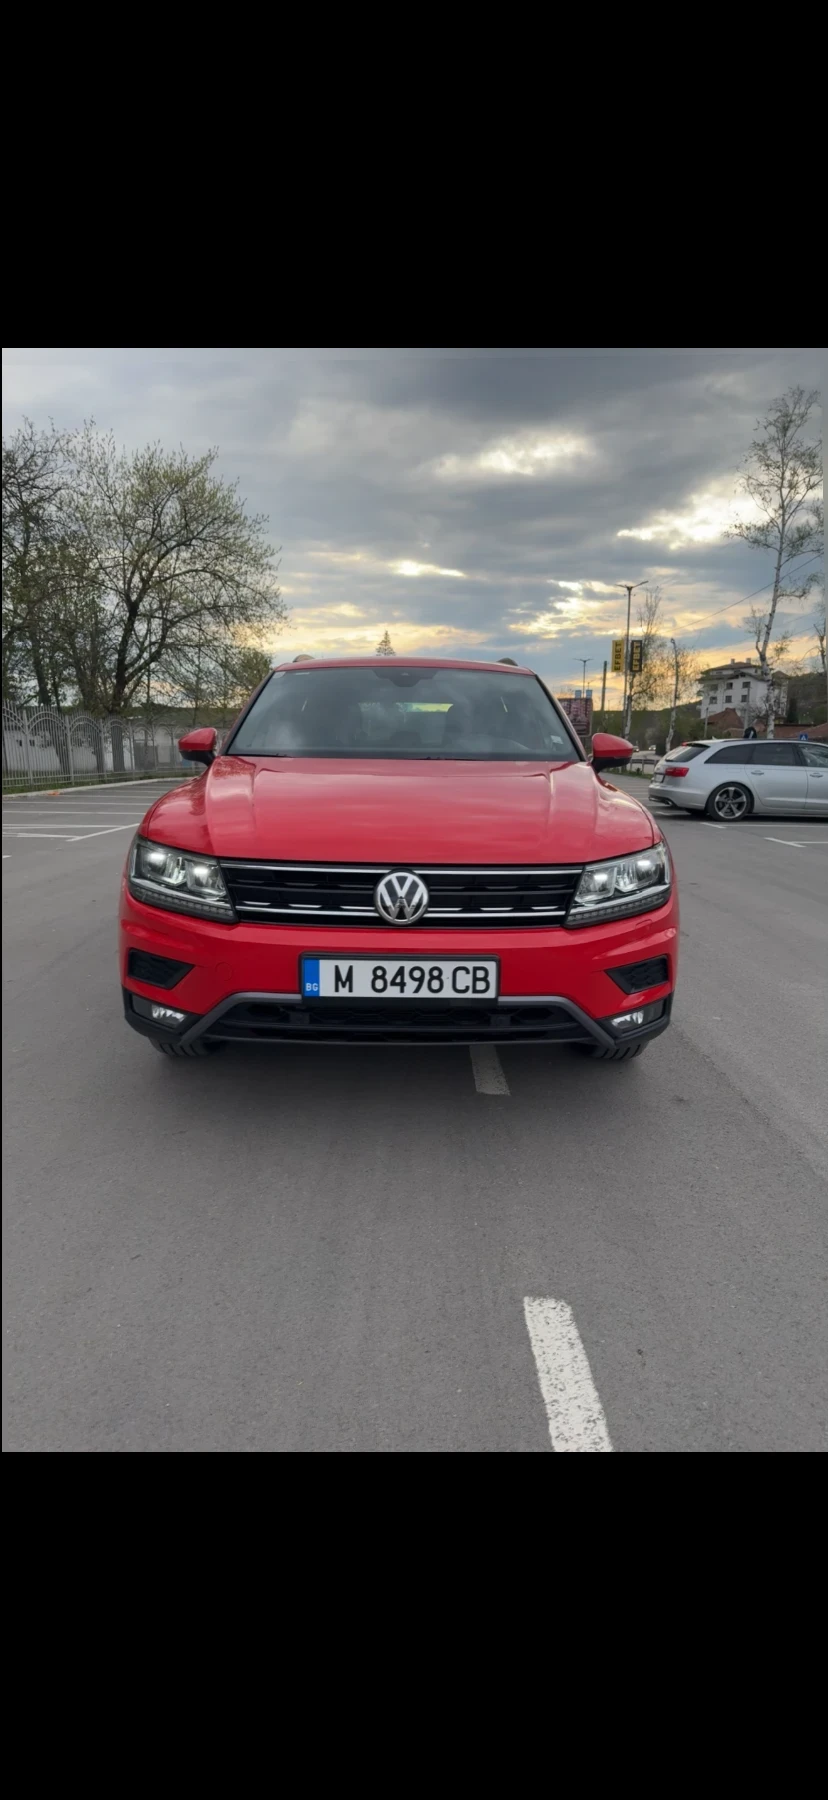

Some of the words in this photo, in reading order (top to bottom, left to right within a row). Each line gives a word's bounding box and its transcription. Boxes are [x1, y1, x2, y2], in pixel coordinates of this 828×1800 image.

[614, 642, 622, 671] EFBET
[377, 872, 429, 925] VW
[305, 982, 319, 991] BG
[334, 964, 354, 993] M
[371, 965, 444, 994] 8498
[451, 965, 491, 994] CB
